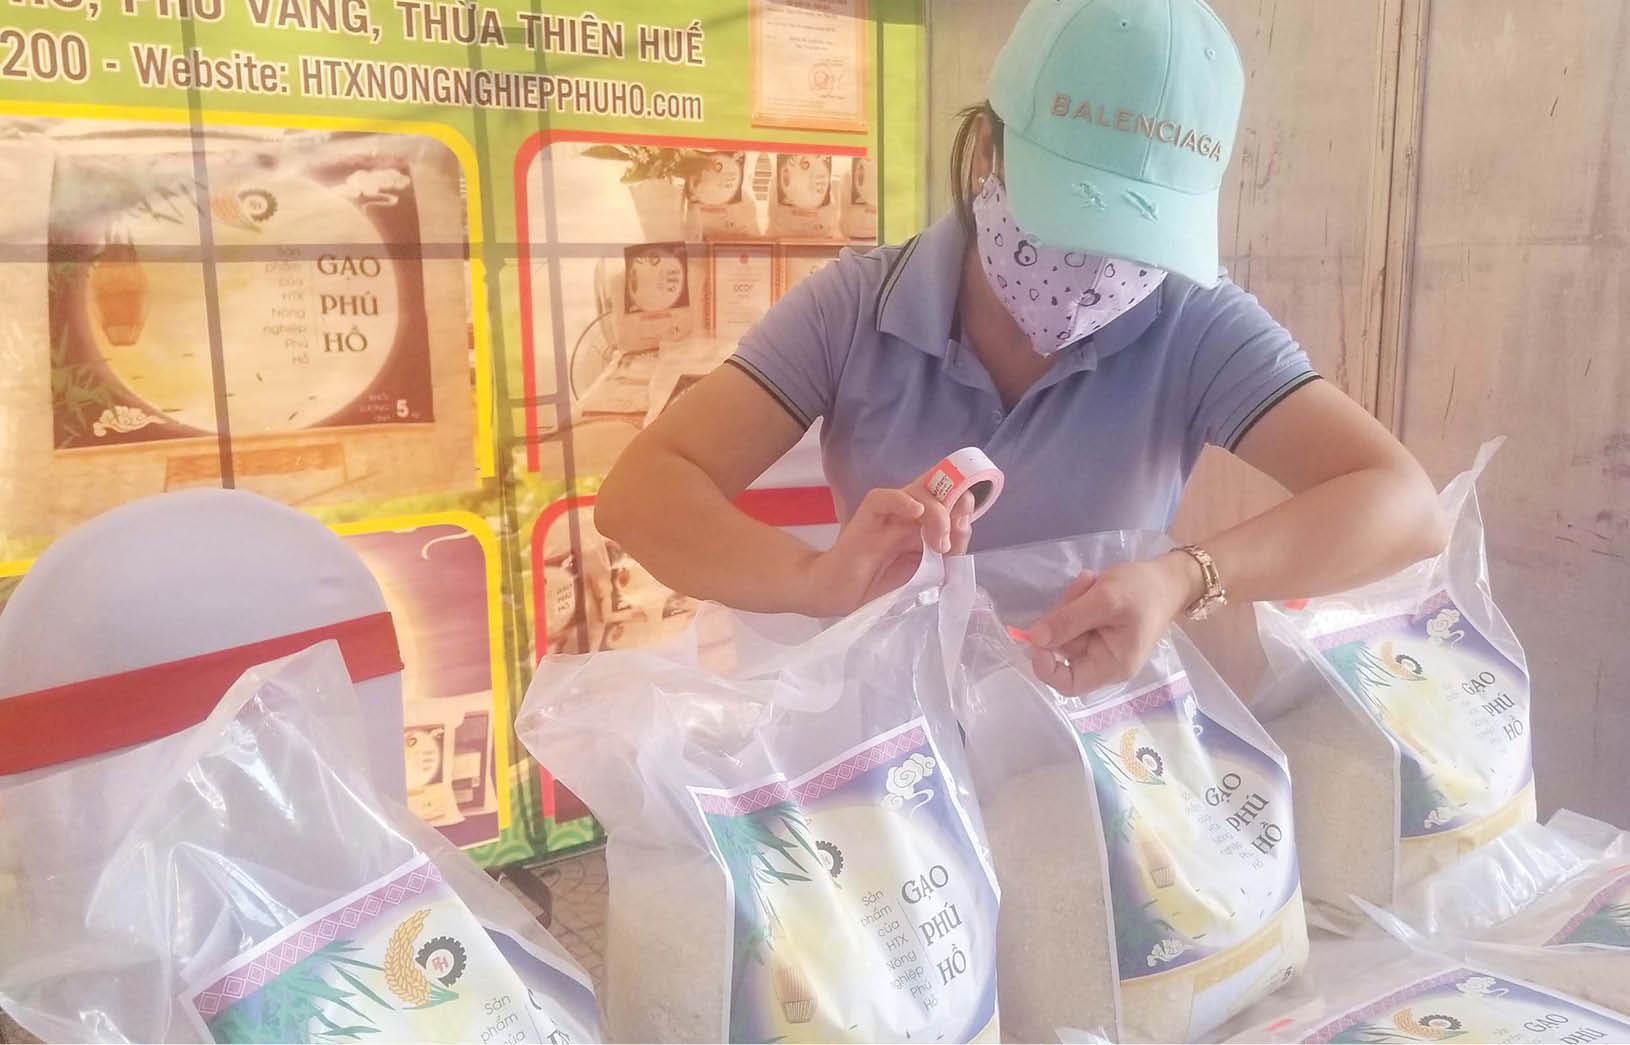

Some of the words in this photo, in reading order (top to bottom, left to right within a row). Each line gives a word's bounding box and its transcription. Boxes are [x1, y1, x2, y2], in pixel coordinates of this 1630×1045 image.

[398, 2, 505, 47] THỪA
[519, 14, 623, 57] THIÊN
[640, 20, 703, 65] HUẾ
[1, 30, 87, 80] 200
[133, 46, 288, 93] Website:
[303, 59, 702, 120] HTXNONGNGHIEPPHUHO.com
[1051, 92, 1223, 162] BALENCIAGA
[317, 253, 380, 280] GẠO
[320, 290, 379, 316] PHÚ
[323, 325, 368, 352] HỒ
[396, 399, 409, 418] 5
[1461, 671, 1496, 695] GẠO
[1205, 773, 1241, 806] GẠO
[1226, 793, 1269, 831] PHÚ
[1251, 821, 1282, 854] HỒ
[901, 865, 949, 904] GẠO
[919, 902, 962, 946] PHÚ
[936, 943, 967, 986] HỒ
[484, 995, 511, 1015] Sản
[1523, 1014, 1569, 1033] GẠO
